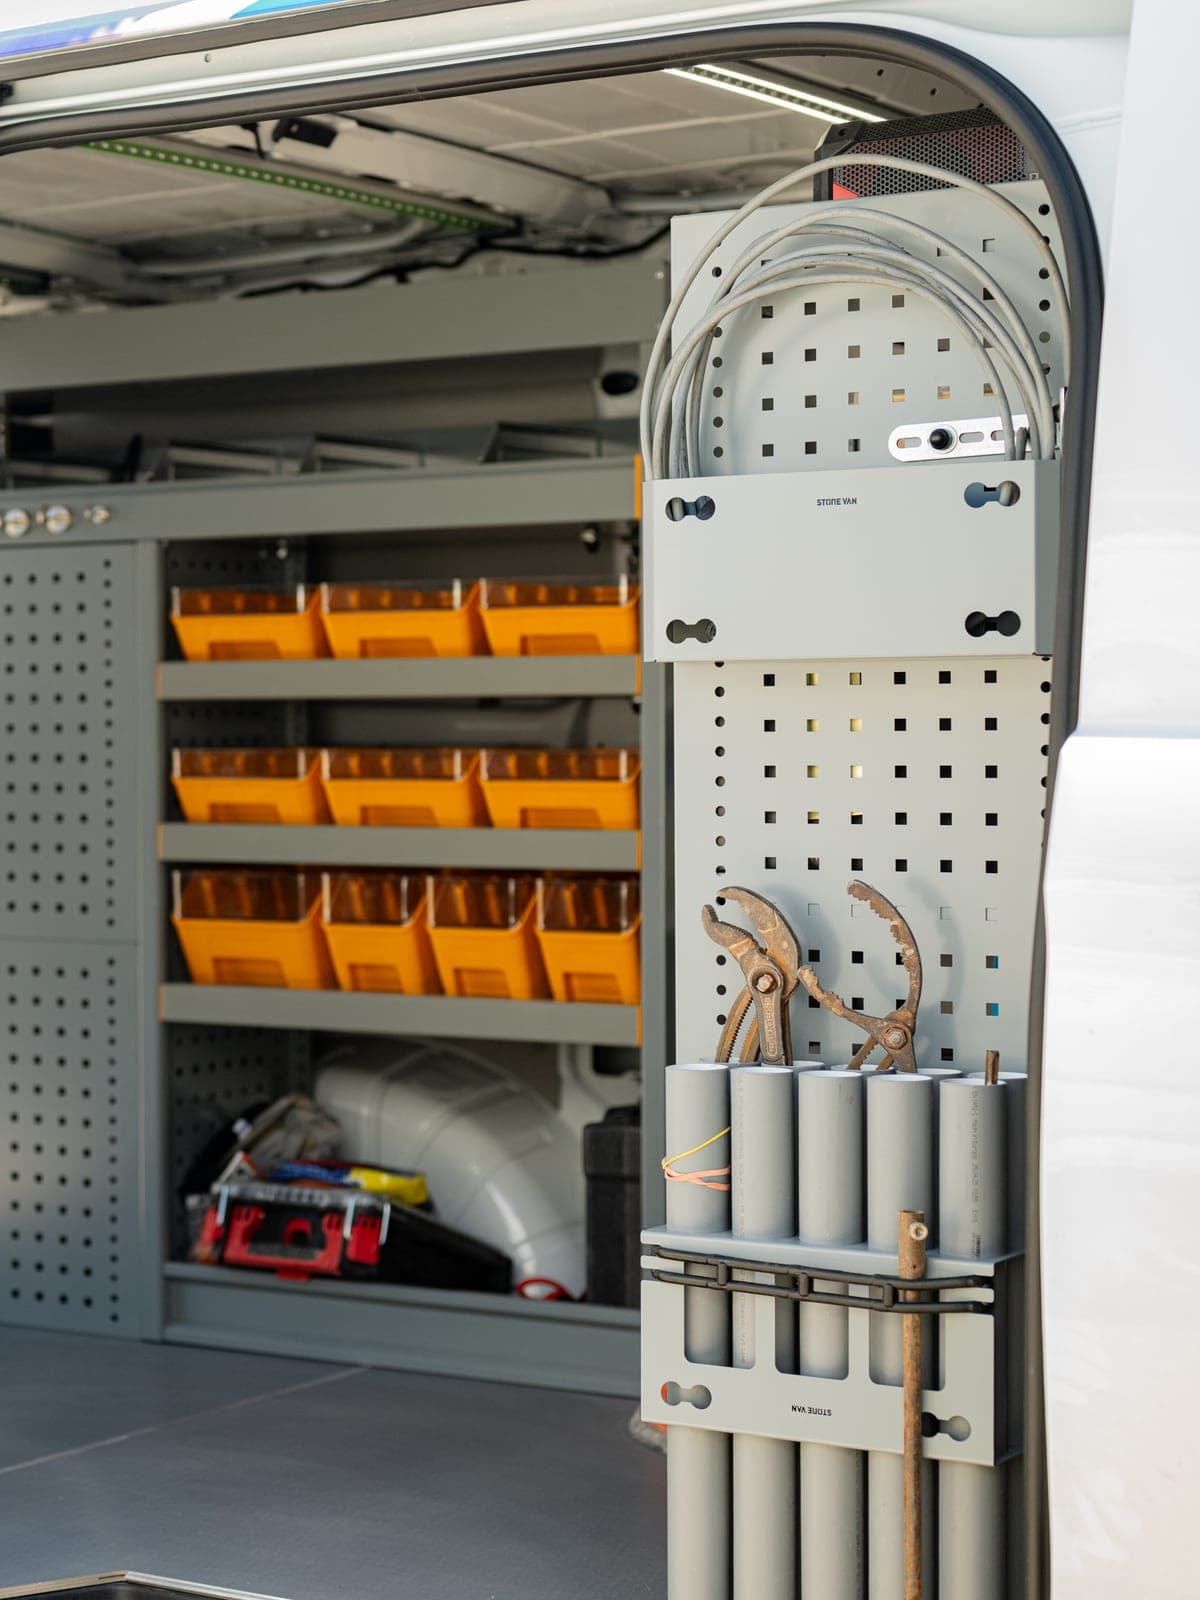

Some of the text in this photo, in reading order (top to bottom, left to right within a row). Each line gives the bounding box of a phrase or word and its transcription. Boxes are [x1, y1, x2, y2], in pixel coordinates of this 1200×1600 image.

[817, 496, 858, 506] STORE VAN
[791, 1404, 832, 1416] STORE VAN
